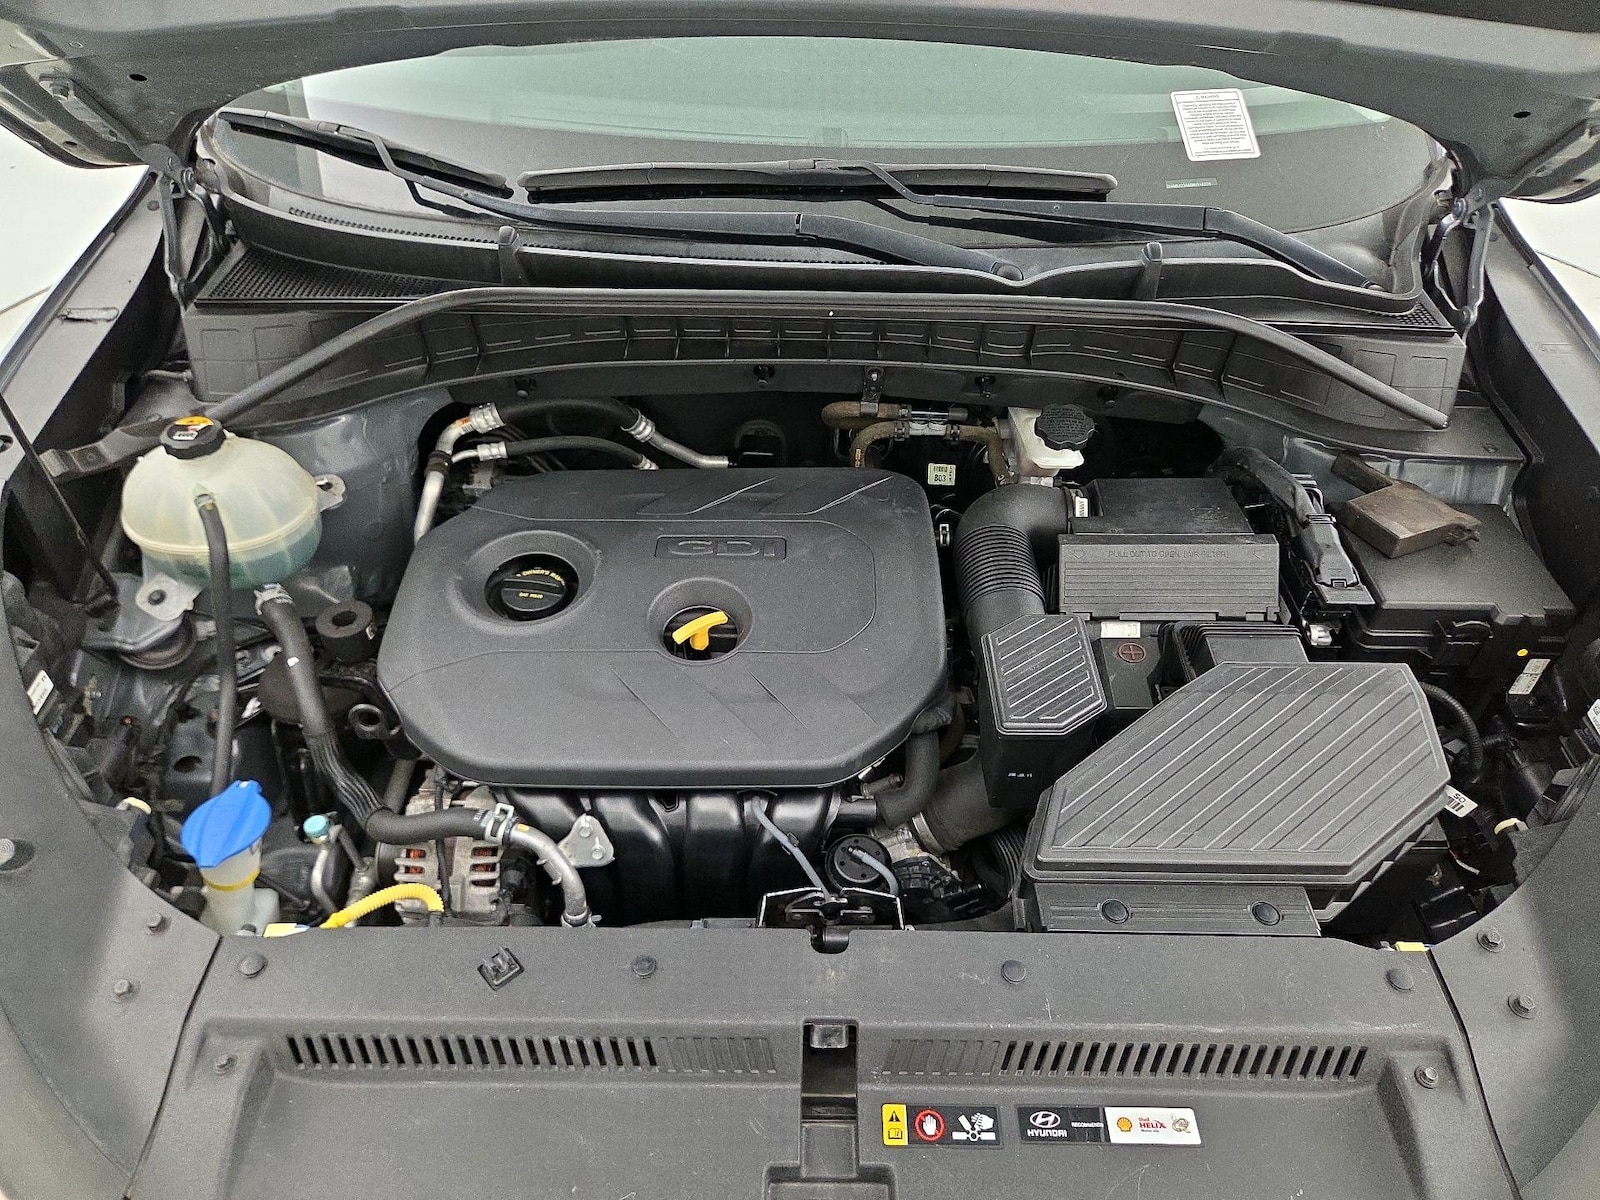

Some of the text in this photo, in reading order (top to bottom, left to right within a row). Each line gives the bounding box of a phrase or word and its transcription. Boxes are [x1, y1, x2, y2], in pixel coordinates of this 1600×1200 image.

[667, 541, 775, 557] GDI
[1139, 1120, 1167, 1129] HELIX
[1027, 1128, 1068, 1138] HYUNDAI
